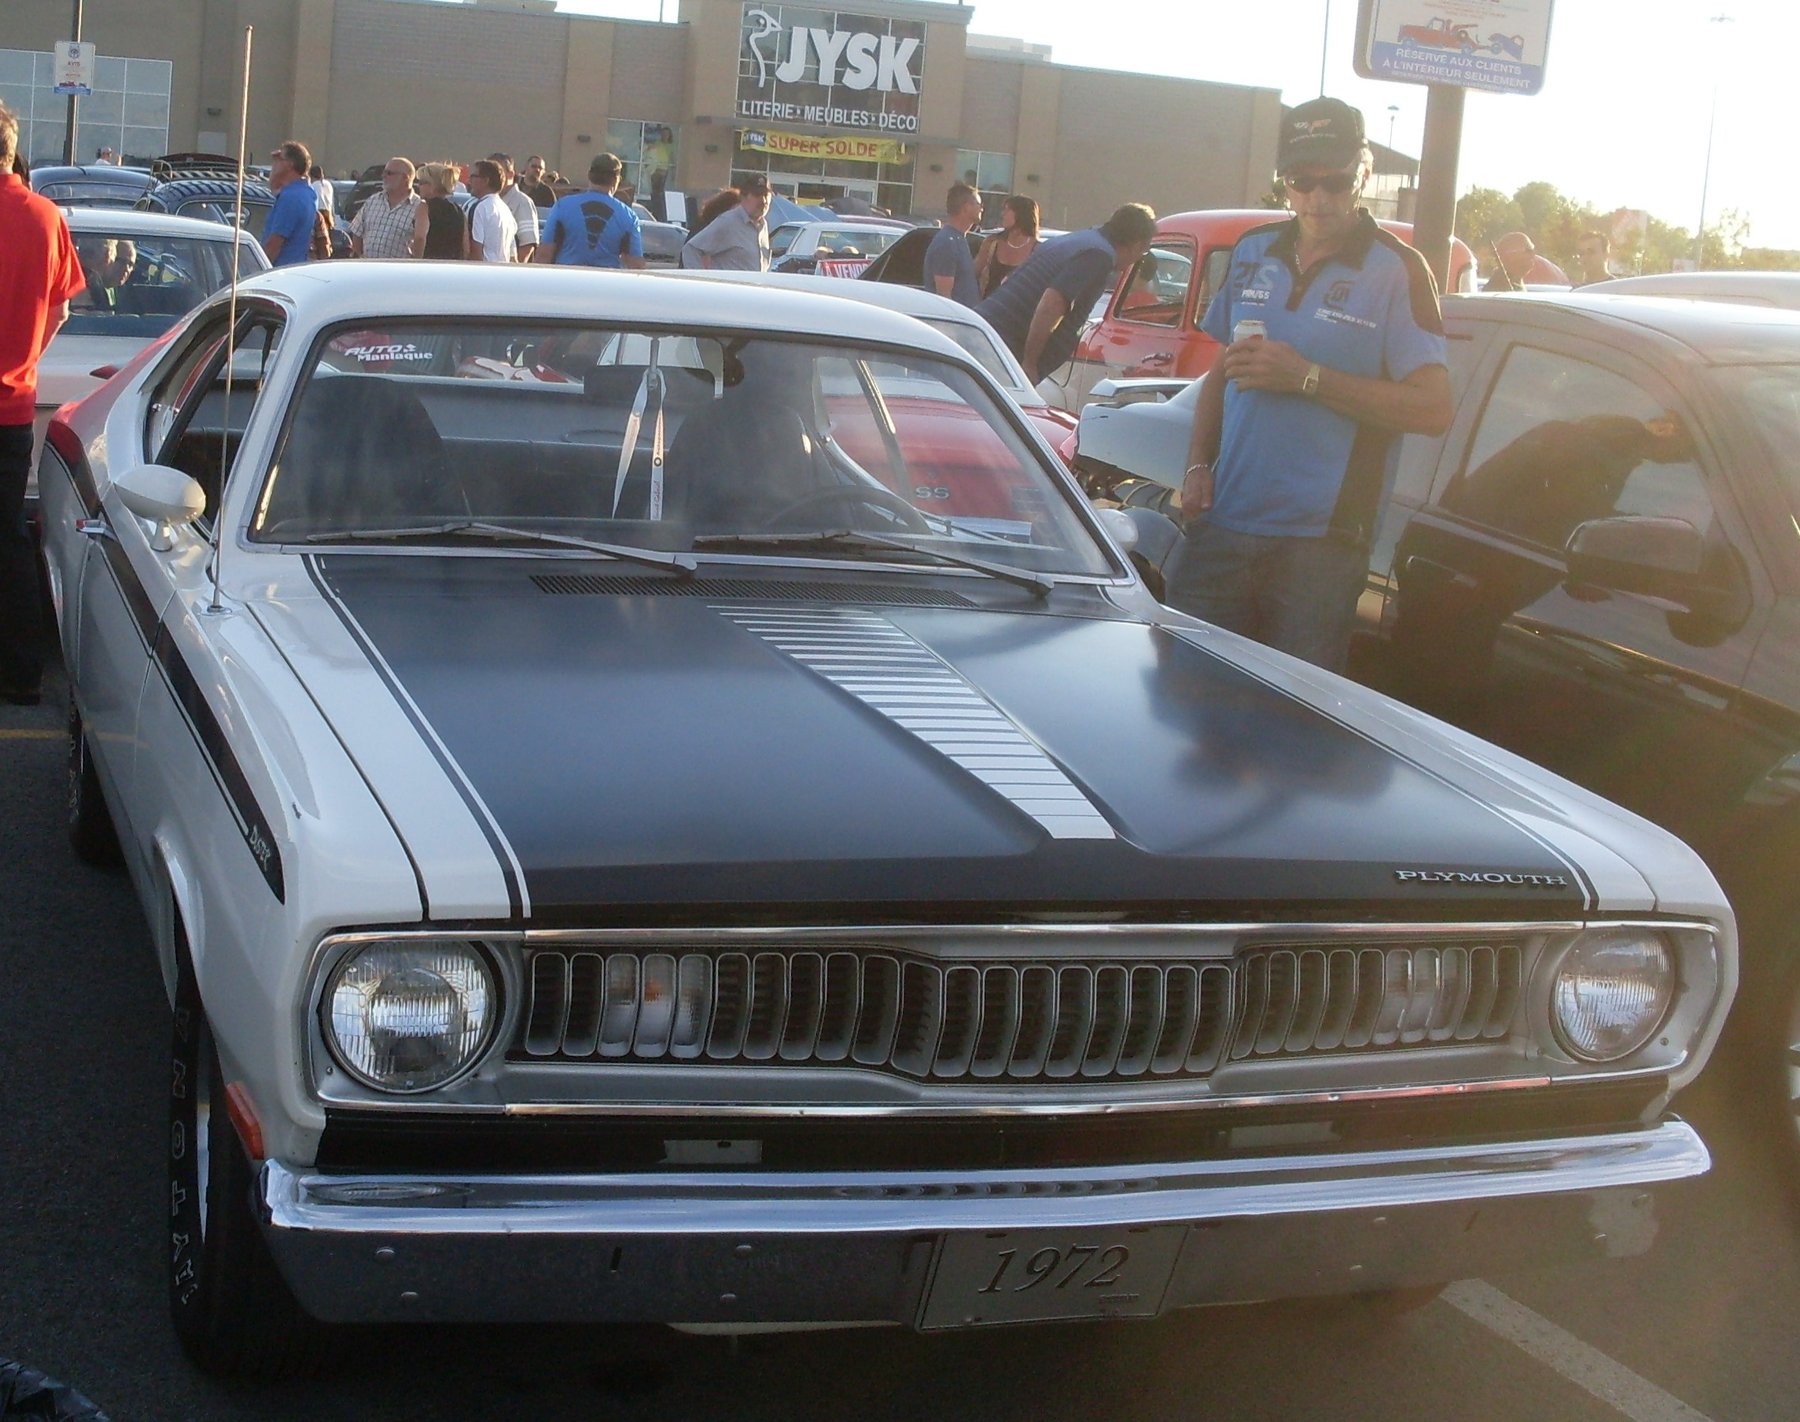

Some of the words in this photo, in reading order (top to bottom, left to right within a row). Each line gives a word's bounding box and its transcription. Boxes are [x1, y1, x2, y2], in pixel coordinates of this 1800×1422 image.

[775, 26, 920, 94] JYSK
[1449, 56, 1473, 68] AUX
[1475, 60, 1522, 75] CLIENTS
[1463, 70, 1531, 88] SEULEMENT
[742, 100, 795, 119] LITERIE
[804, 106, 869, 126] MEUBLES
[878, 110, 917, 130] DÉCO
[769, 134, 820, 153] SUPER
[825, 141, 877, 158] SOLDE
[344, 345, 403, 356] AUTO
[915, 486, 951, 500] SS
[1396, 870, 1568, 886] PLYMOUTH
[978, 1244, 1130, 1293] 1972
